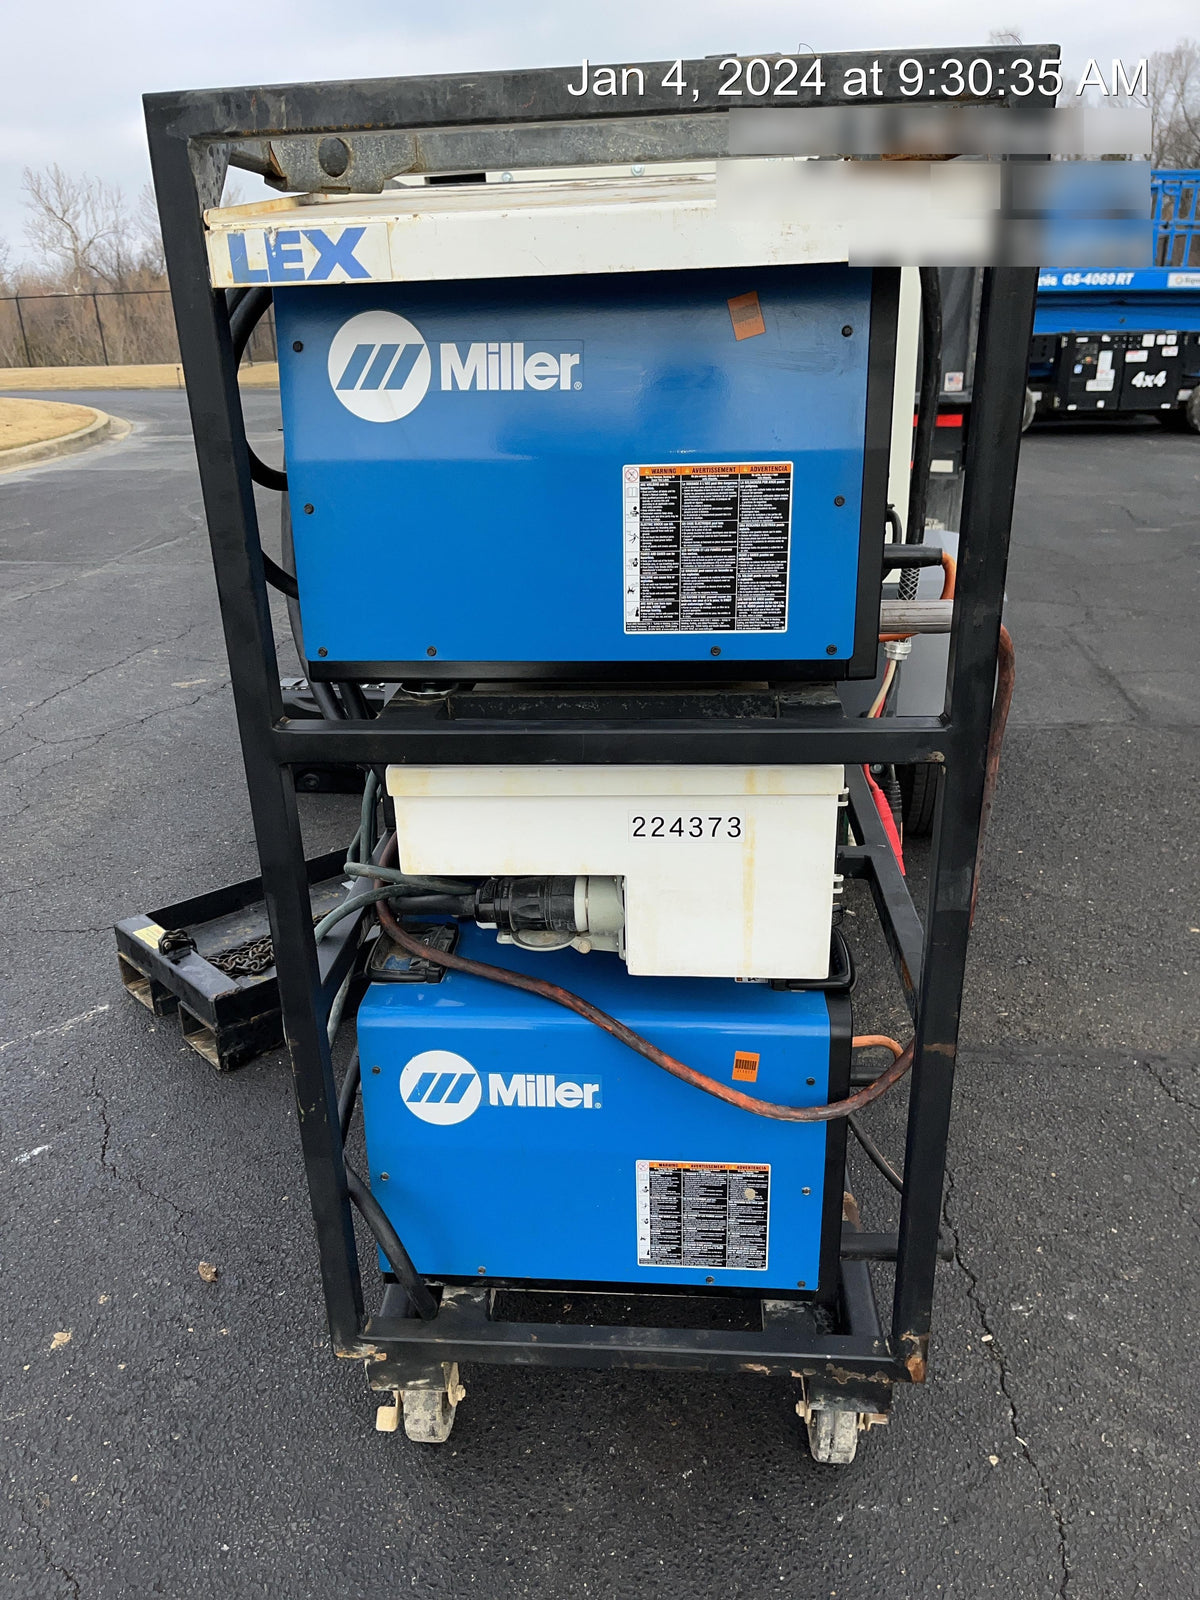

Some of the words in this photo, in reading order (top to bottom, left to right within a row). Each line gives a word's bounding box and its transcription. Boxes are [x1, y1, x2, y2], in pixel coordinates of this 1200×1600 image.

[228, 226, 373, 283] LEX
[1131, 370, 1167, 388] 4x4
[691, 466, 737, 474] AVERTISSEMENT
[632, 816, 741, 838] 224373
